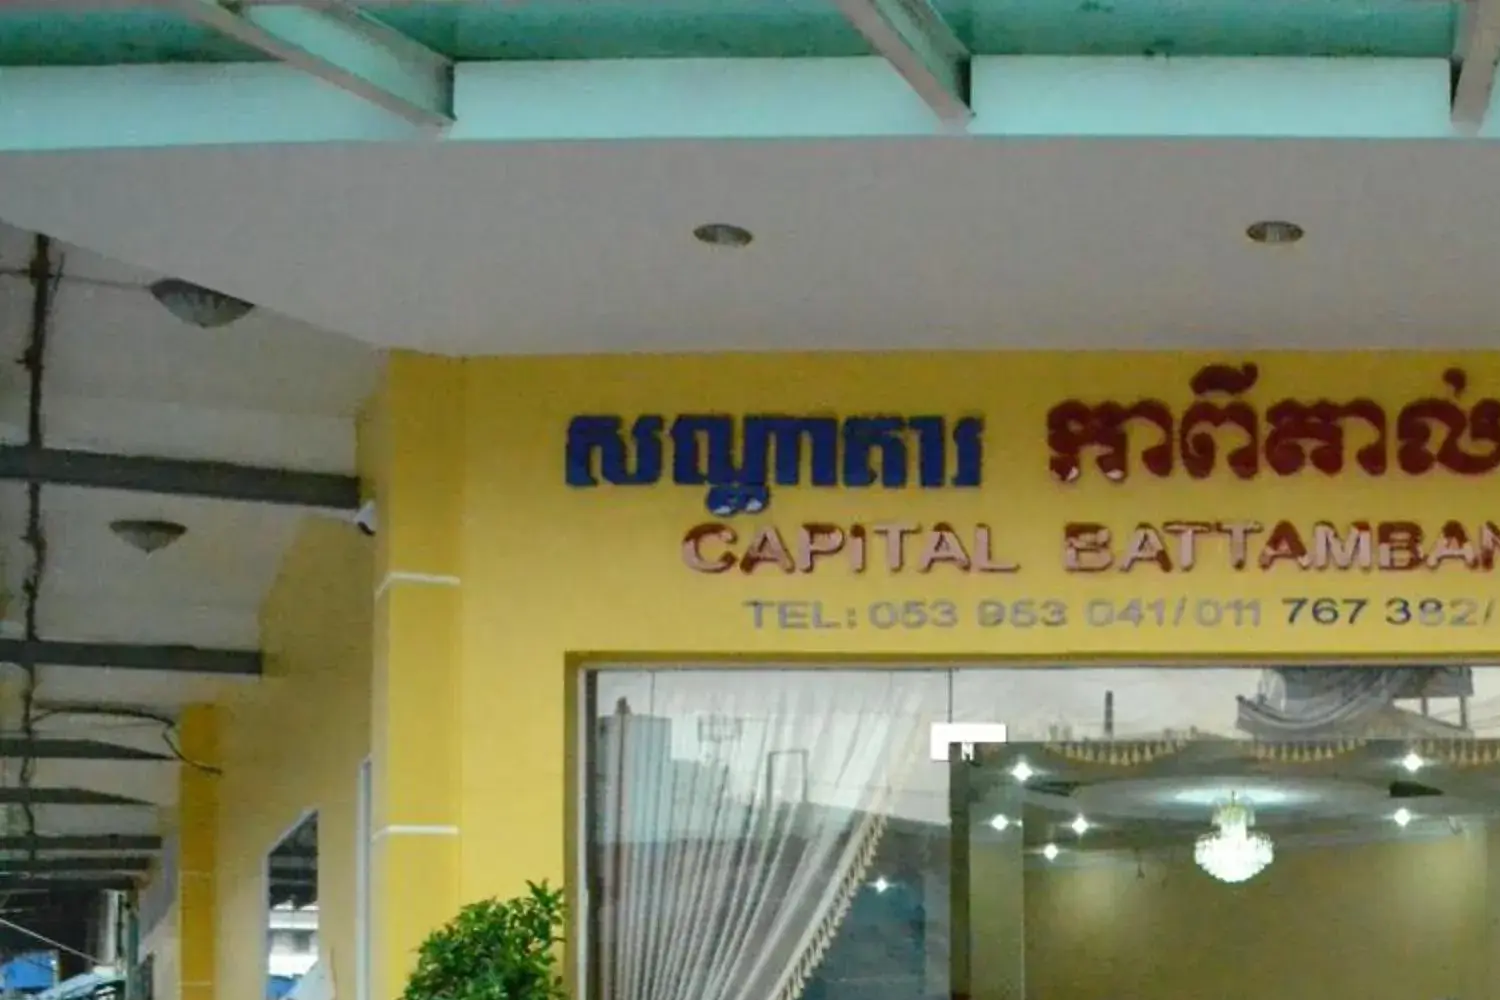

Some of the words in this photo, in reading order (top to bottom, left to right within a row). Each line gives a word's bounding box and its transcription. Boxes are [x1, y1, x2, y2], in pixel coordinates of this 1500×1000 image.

[682, 522, 1019, 573] CAPITAL
[976, 601, 1067, 628] 953
[1282, 599, 1368, 625] 767
